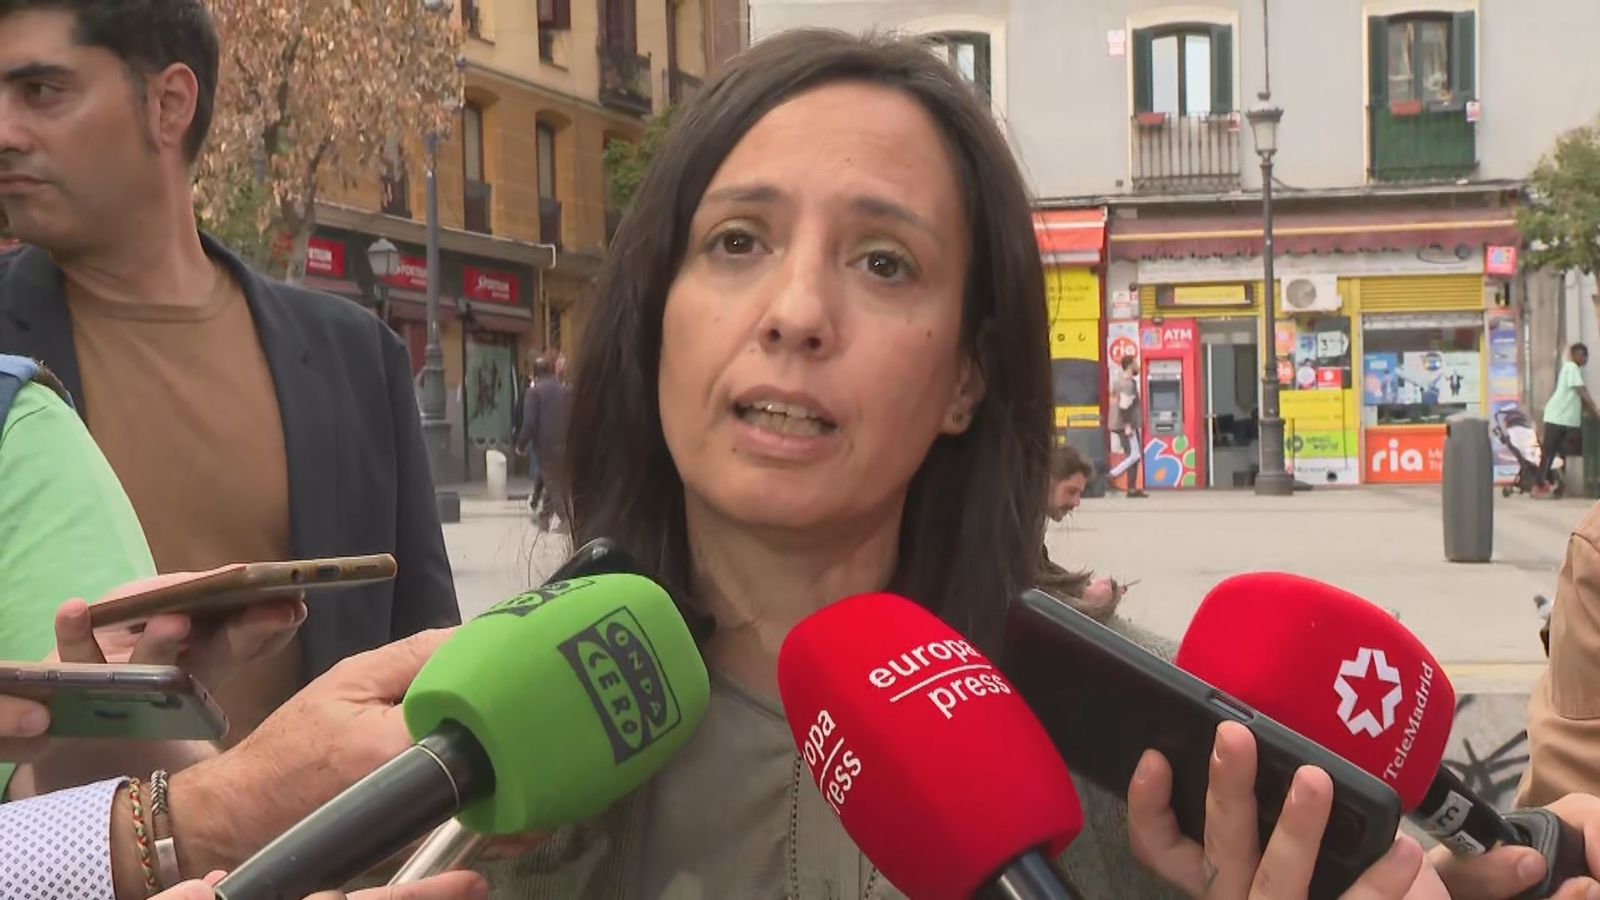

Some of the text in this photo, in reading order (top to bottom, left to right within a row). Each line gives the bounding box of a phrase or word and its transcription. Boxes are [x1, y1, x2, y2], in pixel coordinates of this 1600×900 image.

[1163, 328, 1192, 341] ATM
[1372, 438, 1424, 472] ria
[614, 630, 662, 718] ONDA
[868, 638, 982, 688] europa
[588, 651, 640, 736] CERO
[927, 673, 1011, 719] press
[1383, 661, 1434, 780] TeleMadrid
[826, 750, 862, 815] ress
